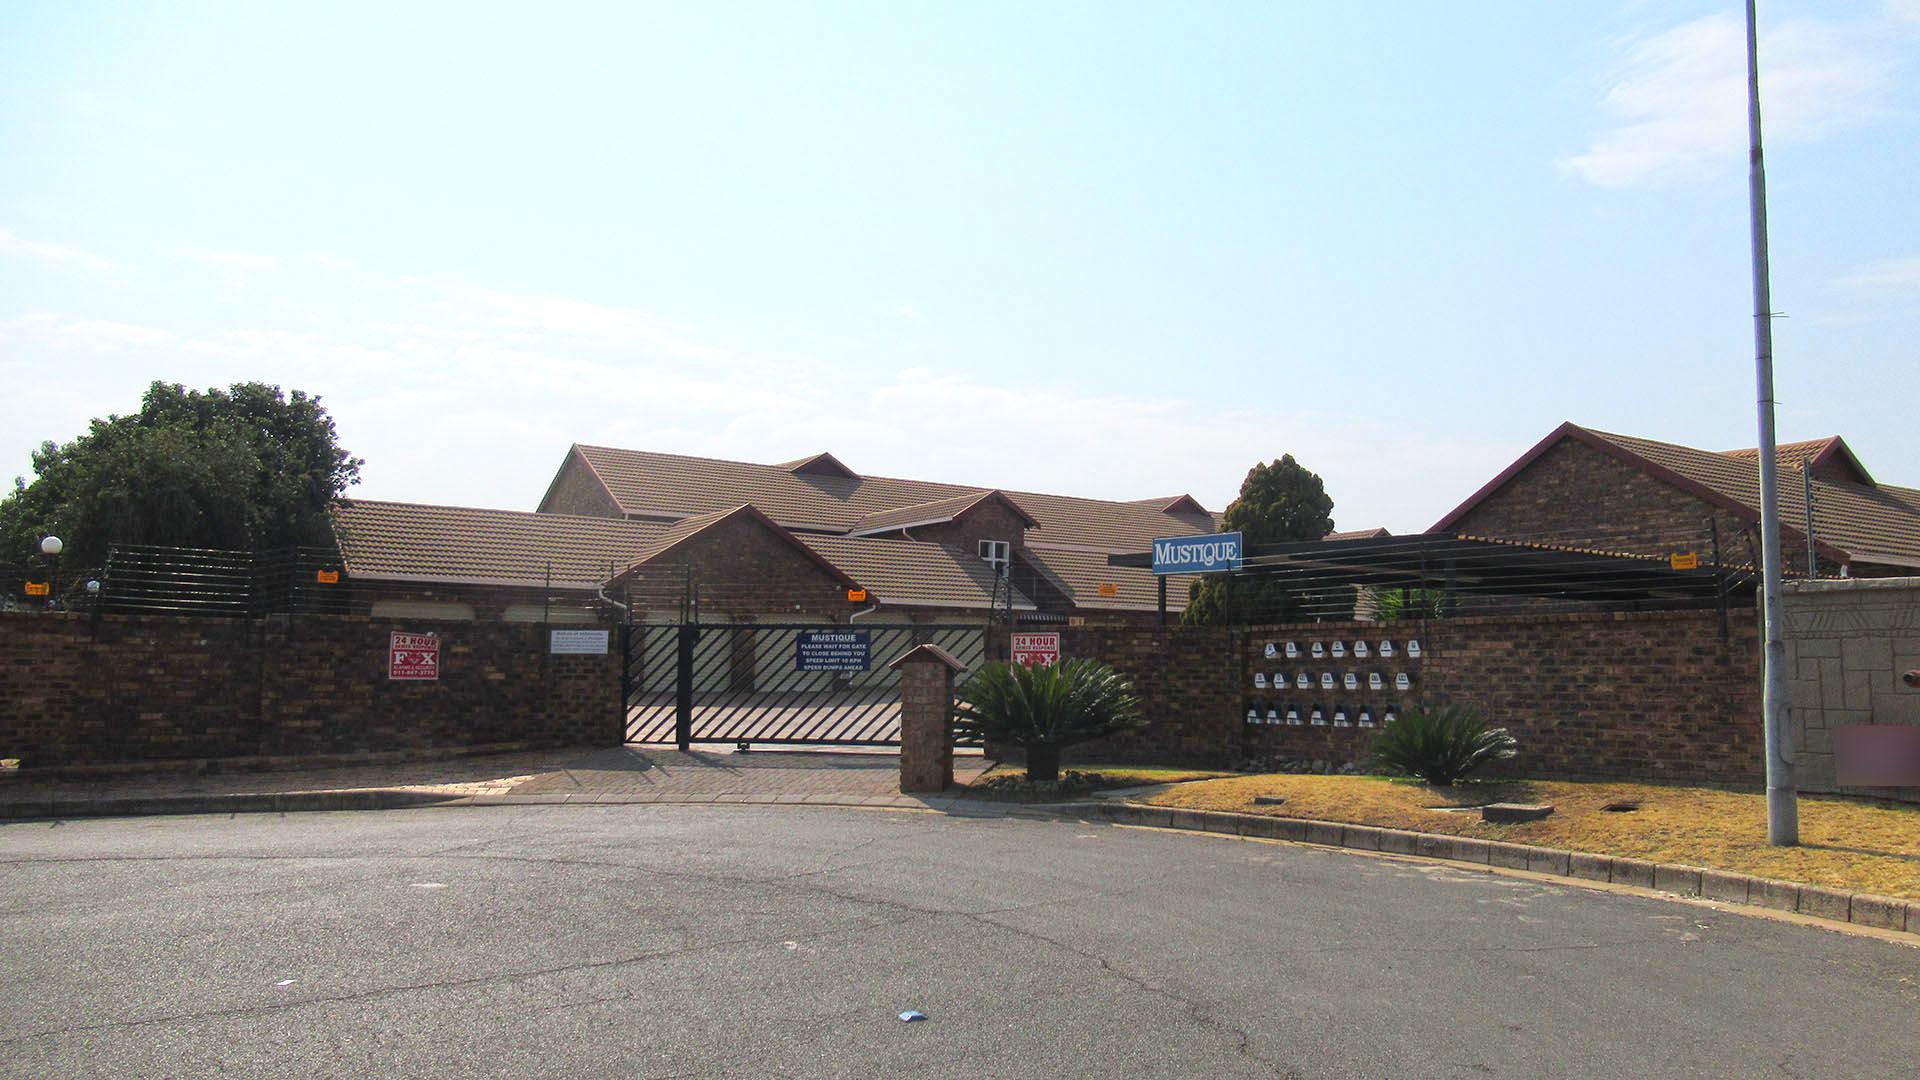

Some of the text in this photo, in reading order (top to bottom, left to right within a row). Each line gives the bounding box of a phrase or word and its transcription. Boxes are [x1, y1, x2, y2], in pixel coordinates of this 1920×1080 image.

[1154, 541, 1237, 566] MUSTIQUE
[395, 636, 437, 646] 24 HOUR
[811, 634, 857, 642] MUSTIQUE
[1015, 637, 1055, 645] 24 HOUR
